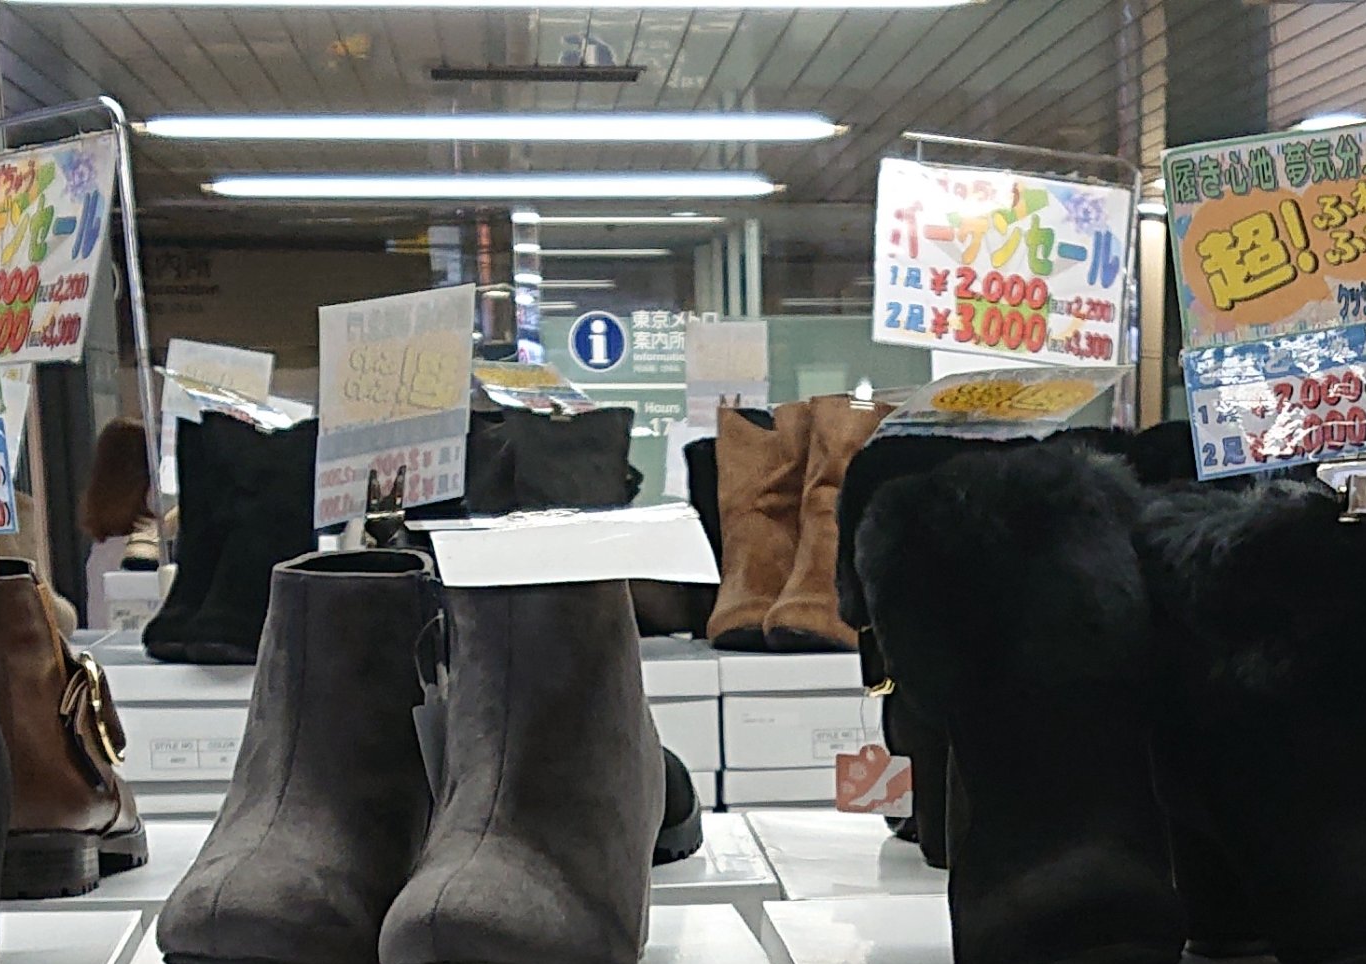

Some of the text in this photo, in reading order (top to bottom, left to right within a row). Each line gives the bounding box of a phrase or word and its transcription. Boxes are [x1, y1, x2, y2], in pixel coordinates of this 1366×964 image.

[1171, 134, 1361, 203] 履き心地 夢気分
[1196, 198, 1319, 310] 超!
[633, 331, 685, 349] 案内所
[633, 353, 685, 361] Informatio
